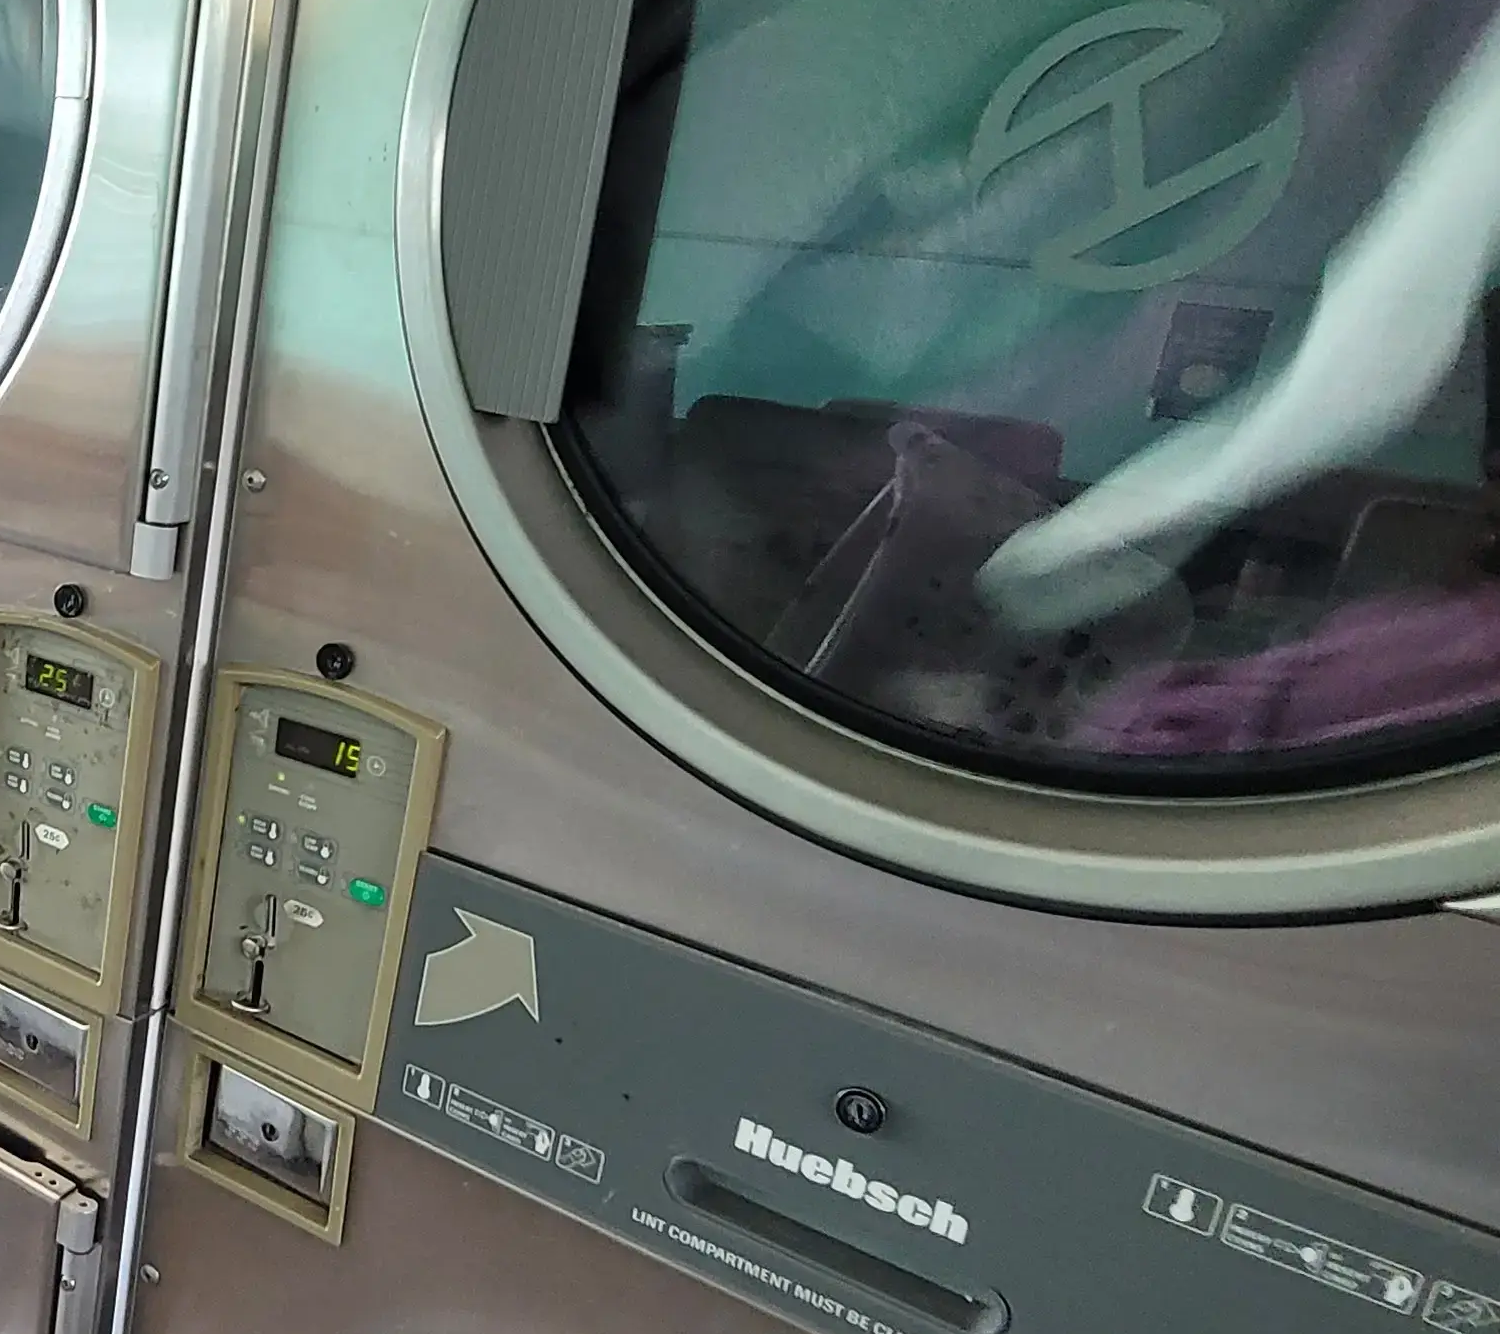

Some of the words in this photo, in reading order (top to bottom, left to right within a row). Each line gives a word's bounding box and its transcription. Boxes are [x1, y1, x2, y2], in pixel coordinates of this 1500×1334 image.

[39, 663, 68, 693] 25
[335, 741, 361, 772] 15
[733, 1116, 970, 1246] Huebsch
[631, 1206, 666, 1234] LINT
[667, 1223, 793, 1296] COMPARTMENT
[793, 1283, 854, 1319] MUST
[846, 1309, 871, 1332] BE
